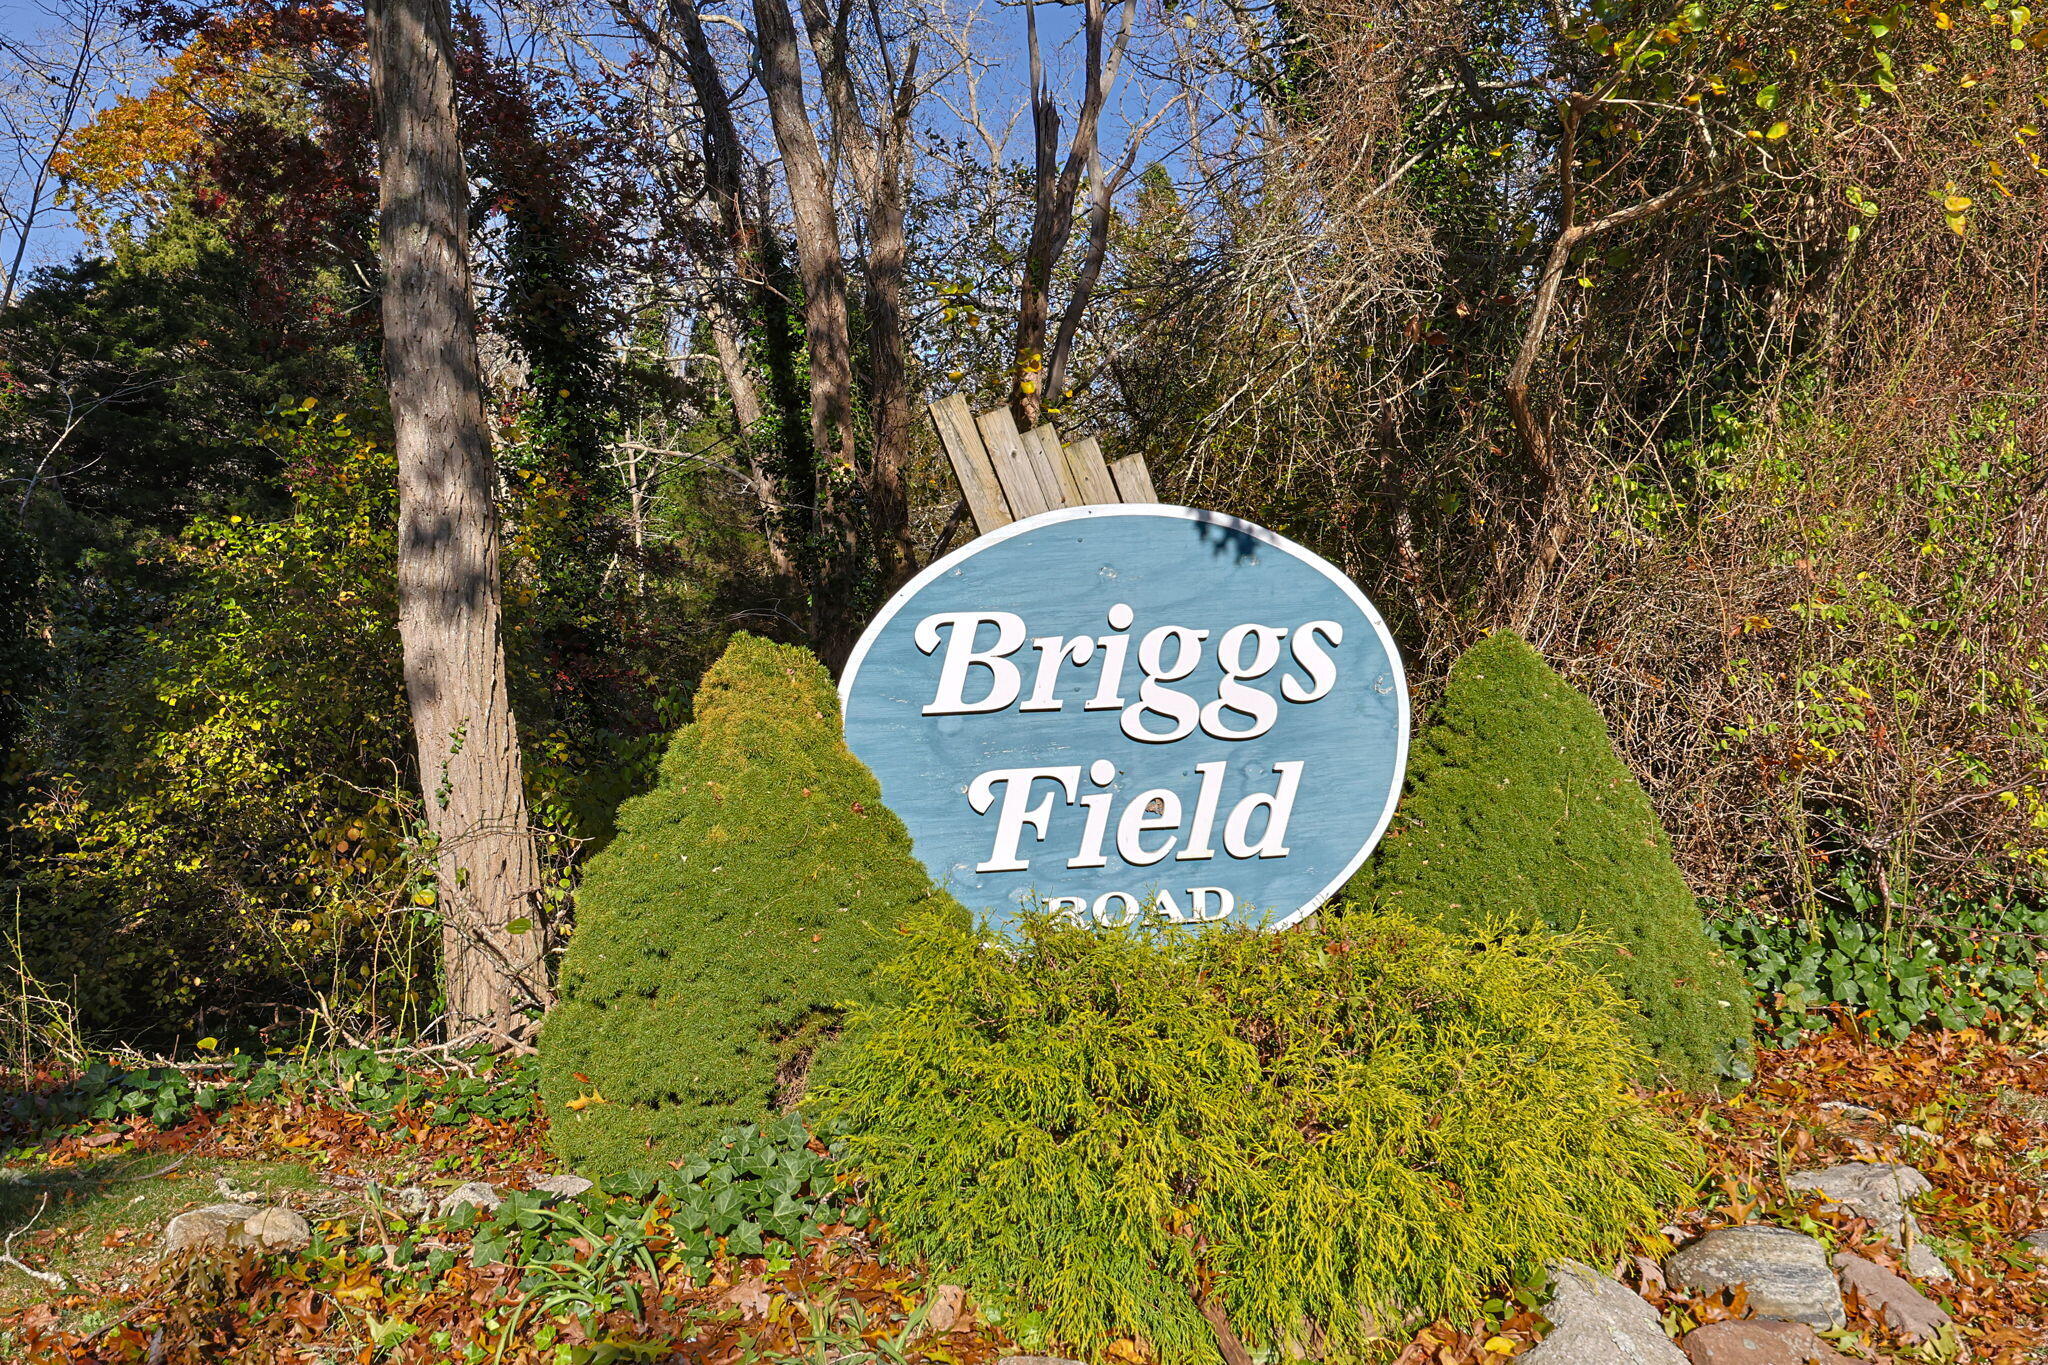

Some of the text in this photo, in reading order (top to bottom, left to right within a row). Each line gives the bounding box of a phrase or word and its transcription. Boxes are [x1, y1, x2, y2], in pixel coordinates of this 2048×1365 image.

[914, 603, 1344, 743] Briggs
[967, 759, 1305, 874] Field
[1042, 886, 1235, 931] ROAD
